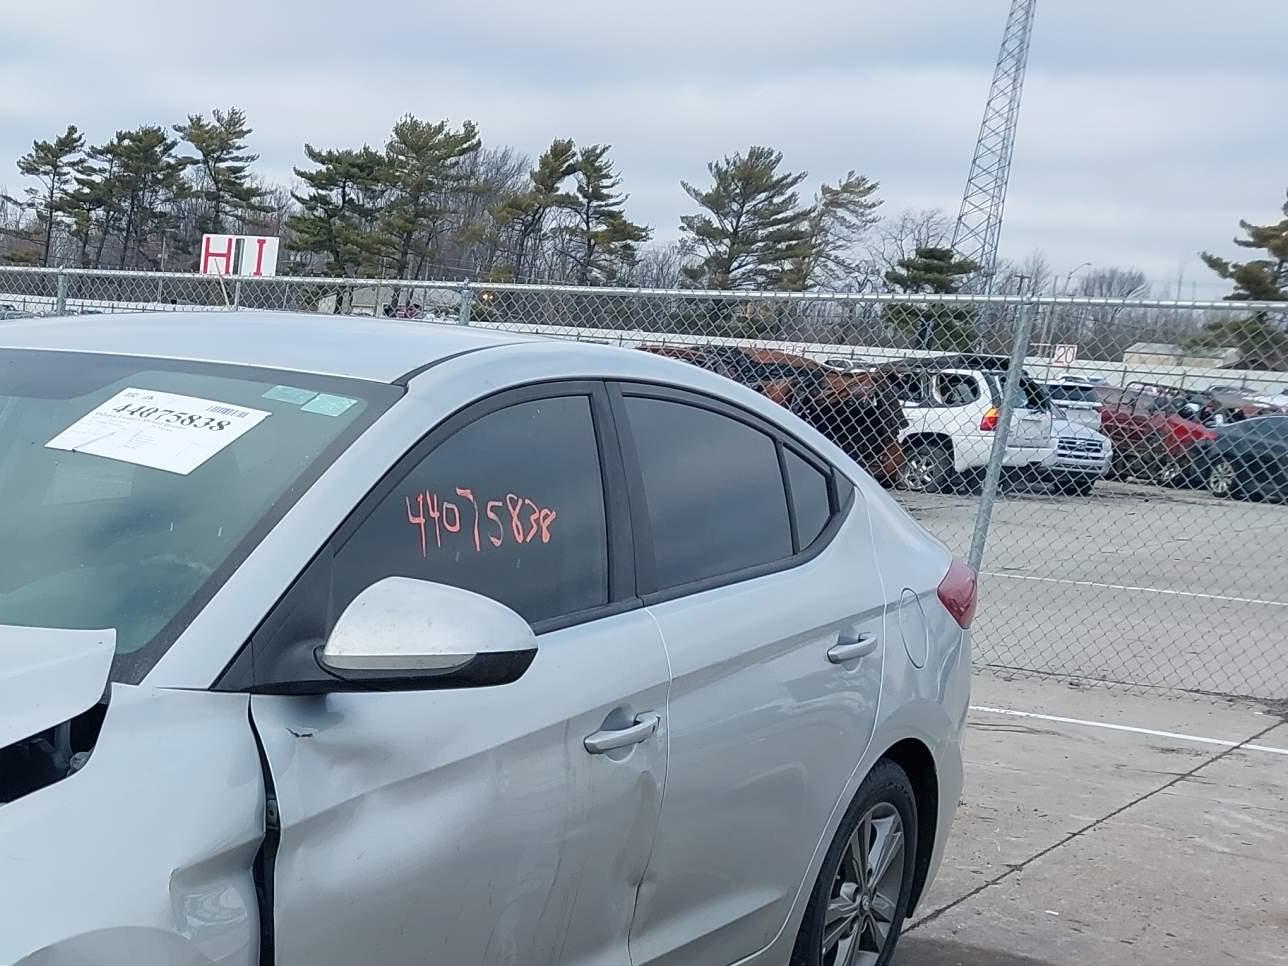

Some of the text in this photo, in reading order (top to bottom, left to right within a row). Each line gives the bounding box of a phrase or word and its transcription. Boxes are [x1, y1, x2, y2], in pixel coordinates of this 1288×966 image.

[1055, 346, 1075, 364] 20
[112, 403, 231, 431] 44075838
[406, 488, 556, 558] 44075838
